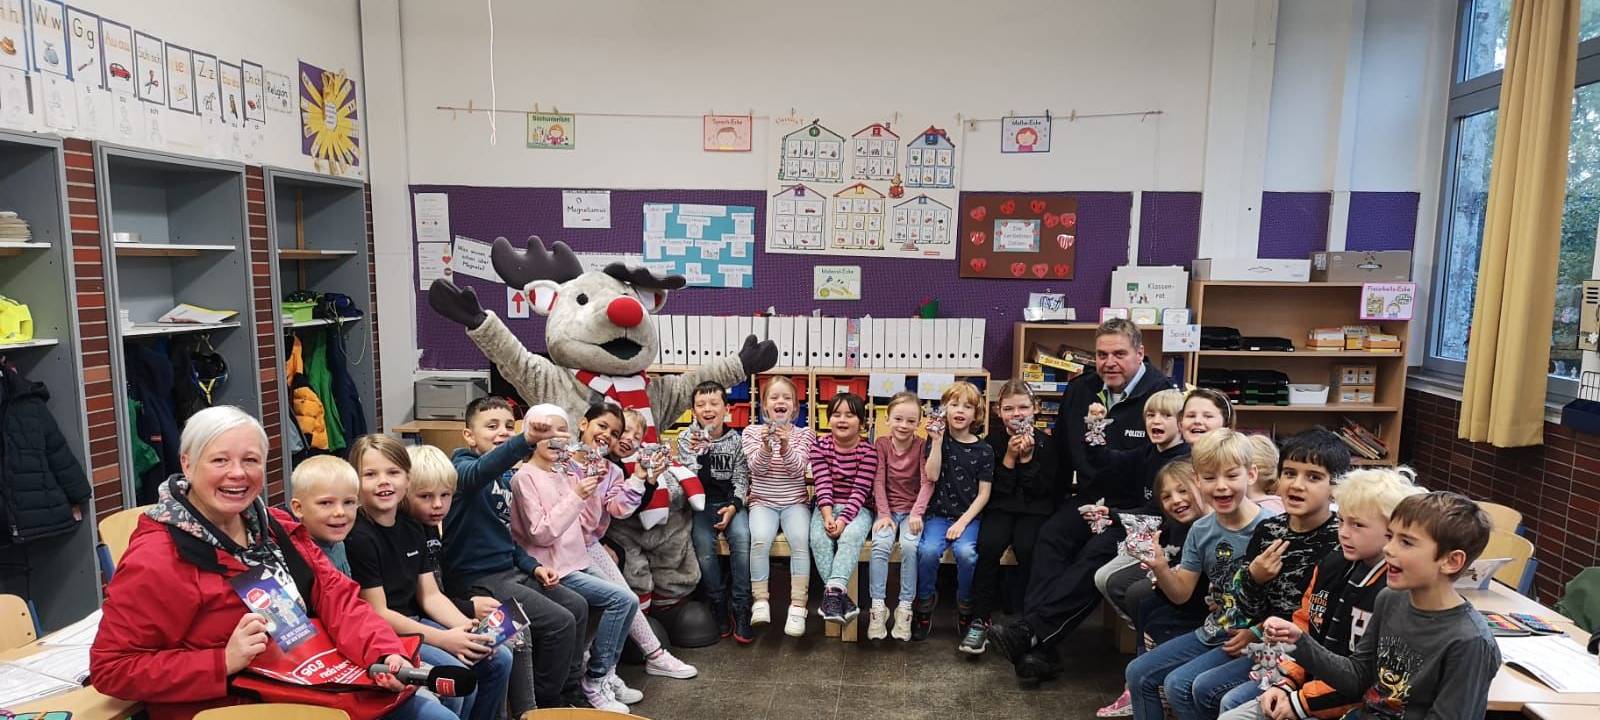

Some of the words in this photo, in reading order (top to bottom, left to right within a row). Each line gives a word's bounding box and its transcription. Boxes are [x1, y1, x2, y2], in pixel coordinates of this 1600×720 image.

[34, 5, 48, 26] W
[51, 18, 62, 32] w
[72, 17, 84, 38] G
[86, 30, 95, 50] g
[197, 59, 207, 78] Z
[566, 205, 607, 215] Magnetismus
[300, 659, 325, 677] 90.8
